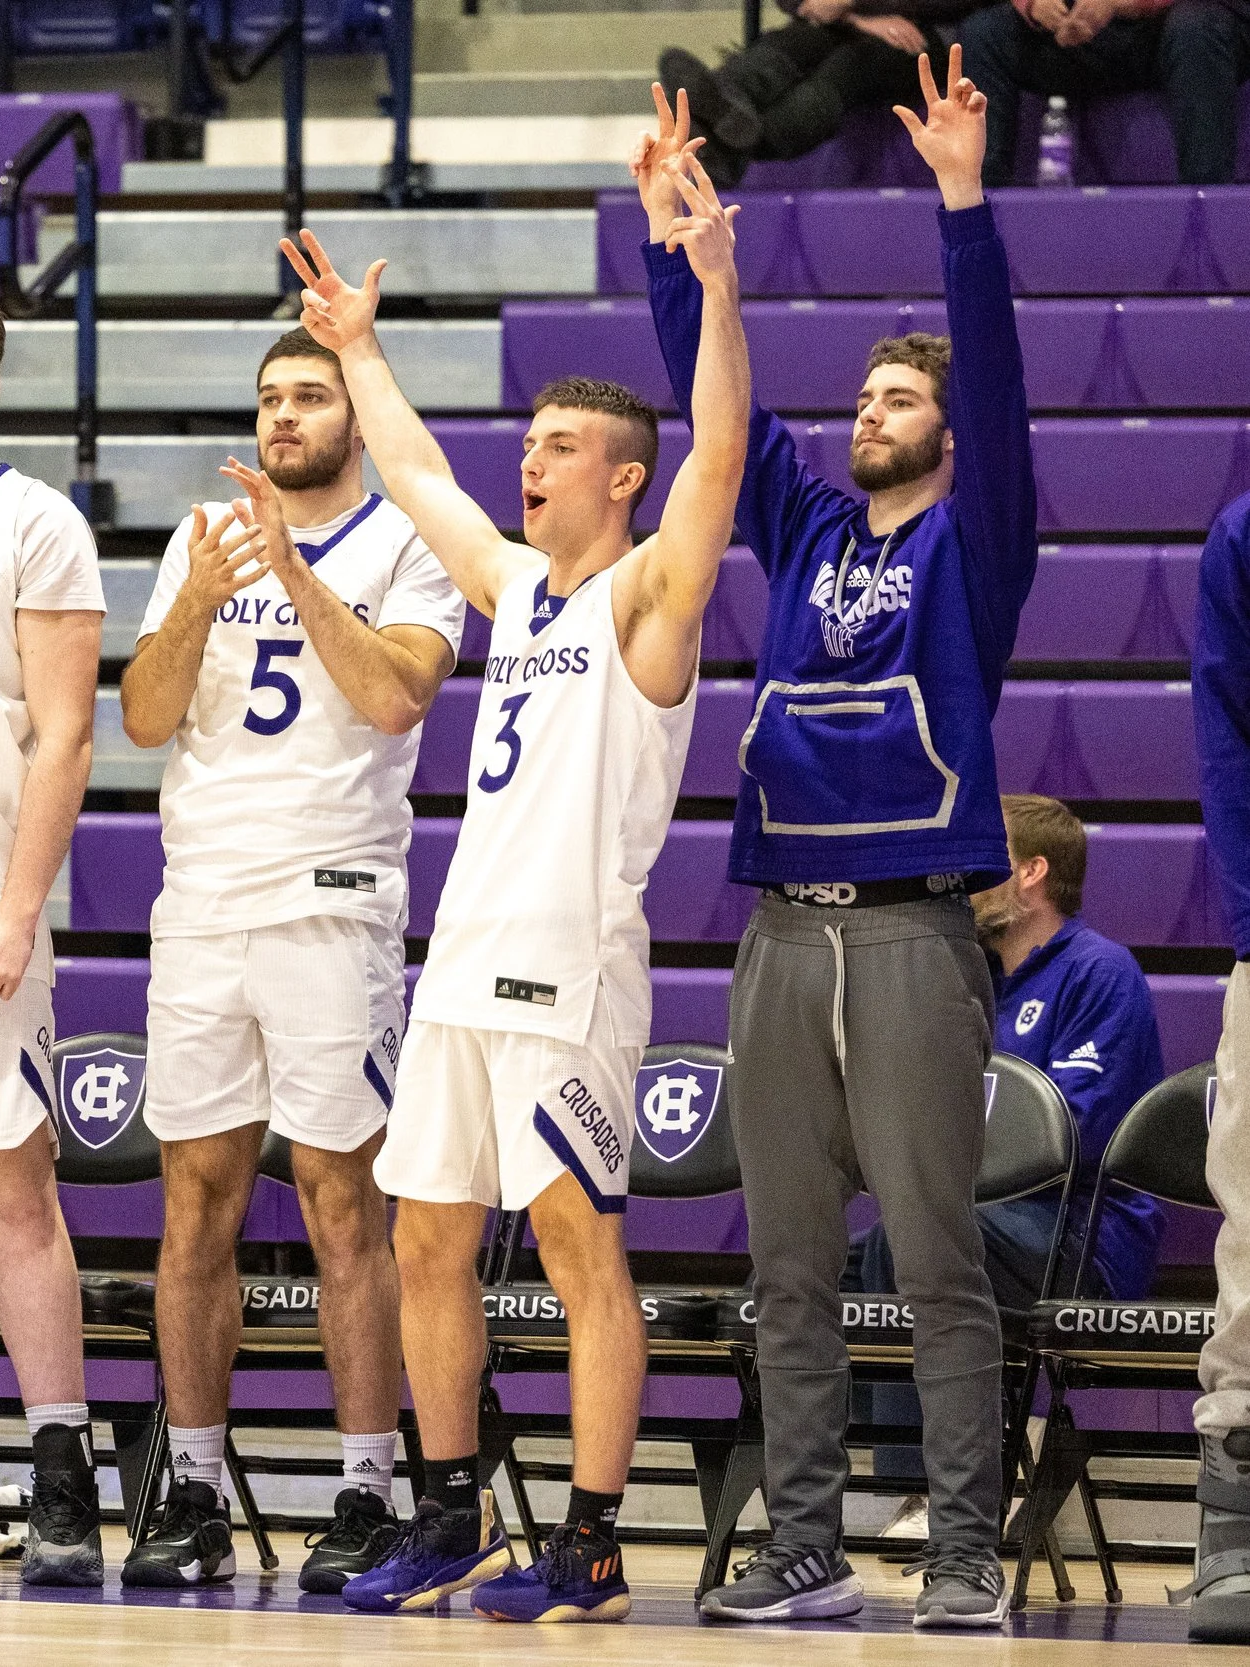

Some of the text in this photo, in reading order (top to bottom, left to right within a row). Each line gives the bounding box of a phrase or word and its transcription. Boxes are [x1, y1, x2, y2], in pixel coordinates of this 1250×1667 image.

[846, 578, 873, 588] adida
[243, 638, 305, 737] 5
[477, 691, 533, 794] 3
[797, 882, 857, 905] PSD
[559, 1077, 624, 1175] CRUSADERS
[1054, 1307, 1216, 1335] CRUSADER
[352, 1465, 380, 1473] adidas
